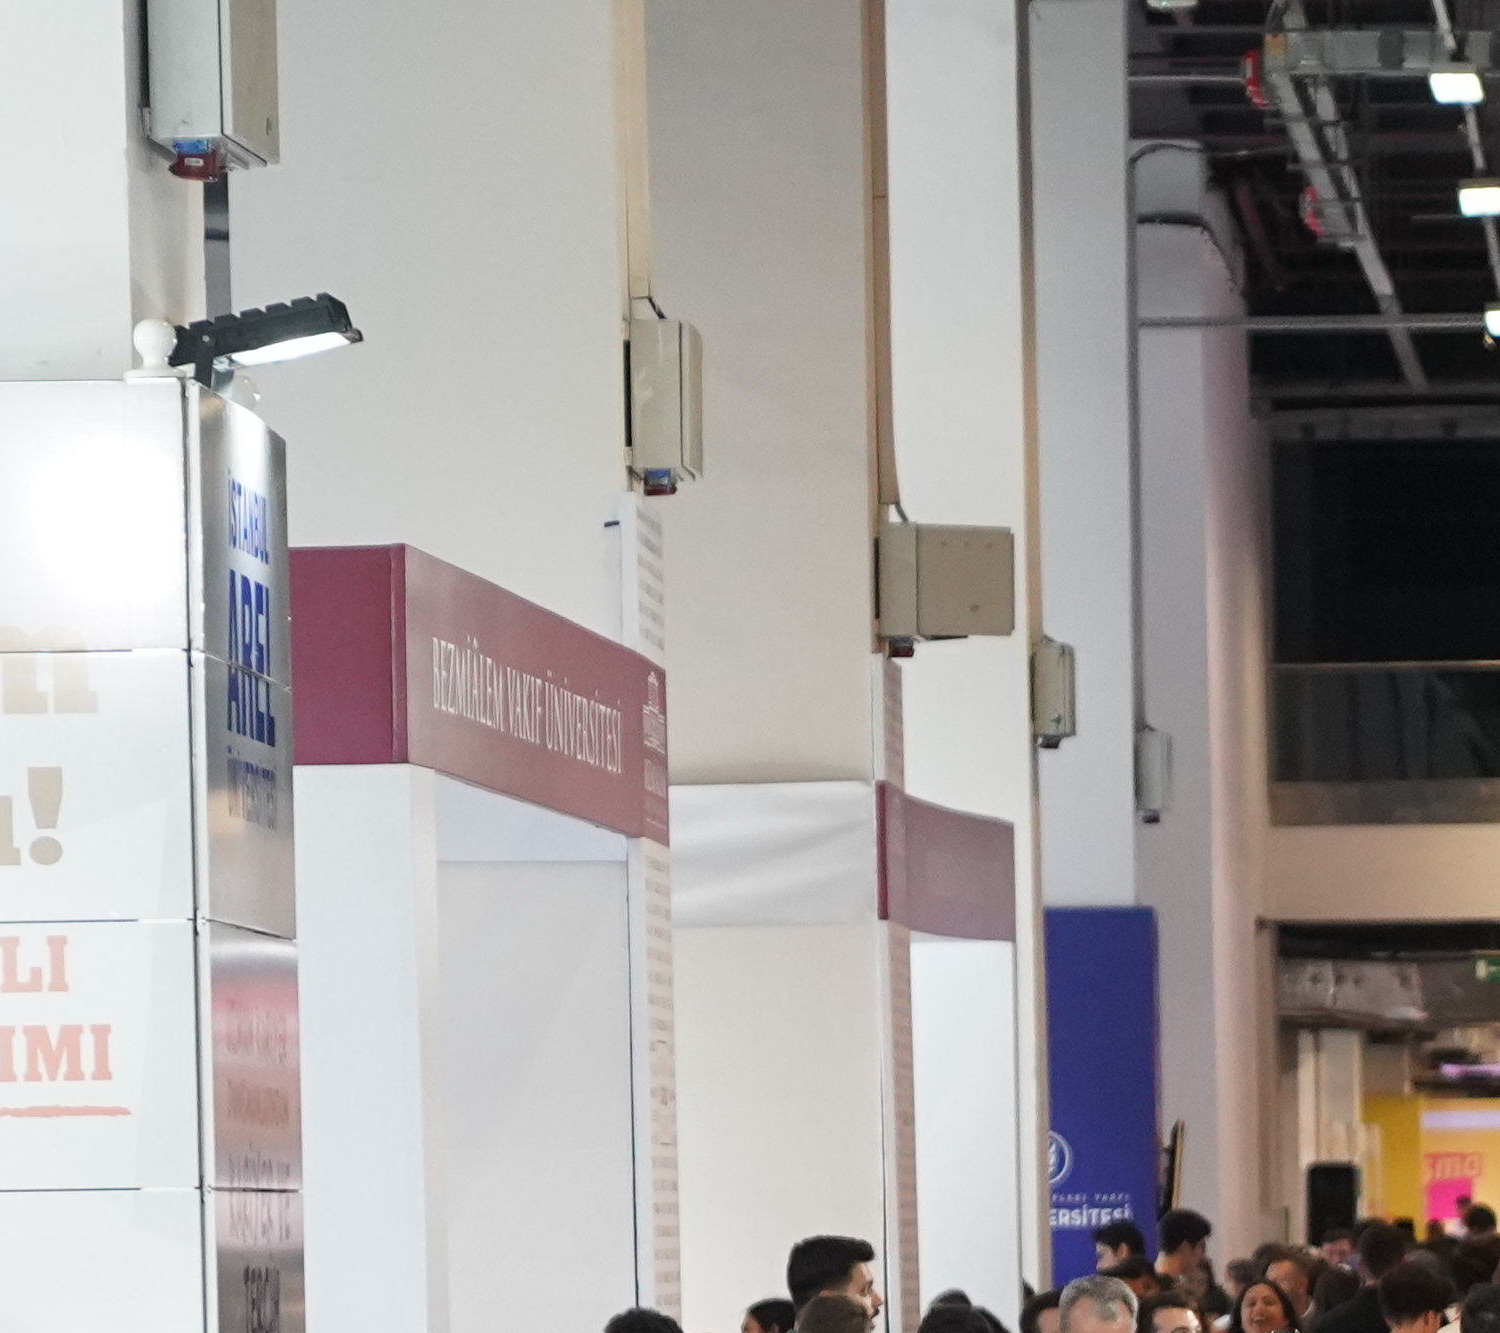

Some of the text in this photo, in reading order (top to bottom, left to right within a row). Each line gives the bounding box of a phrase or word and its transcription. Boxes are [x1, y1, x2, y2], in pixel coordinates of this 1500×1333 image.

[227, 569, 276, 748] AREL
[506, 667, 541, 746] VAKIF
[544, 669, 622, 774] ÜNİVERSİTESİ
